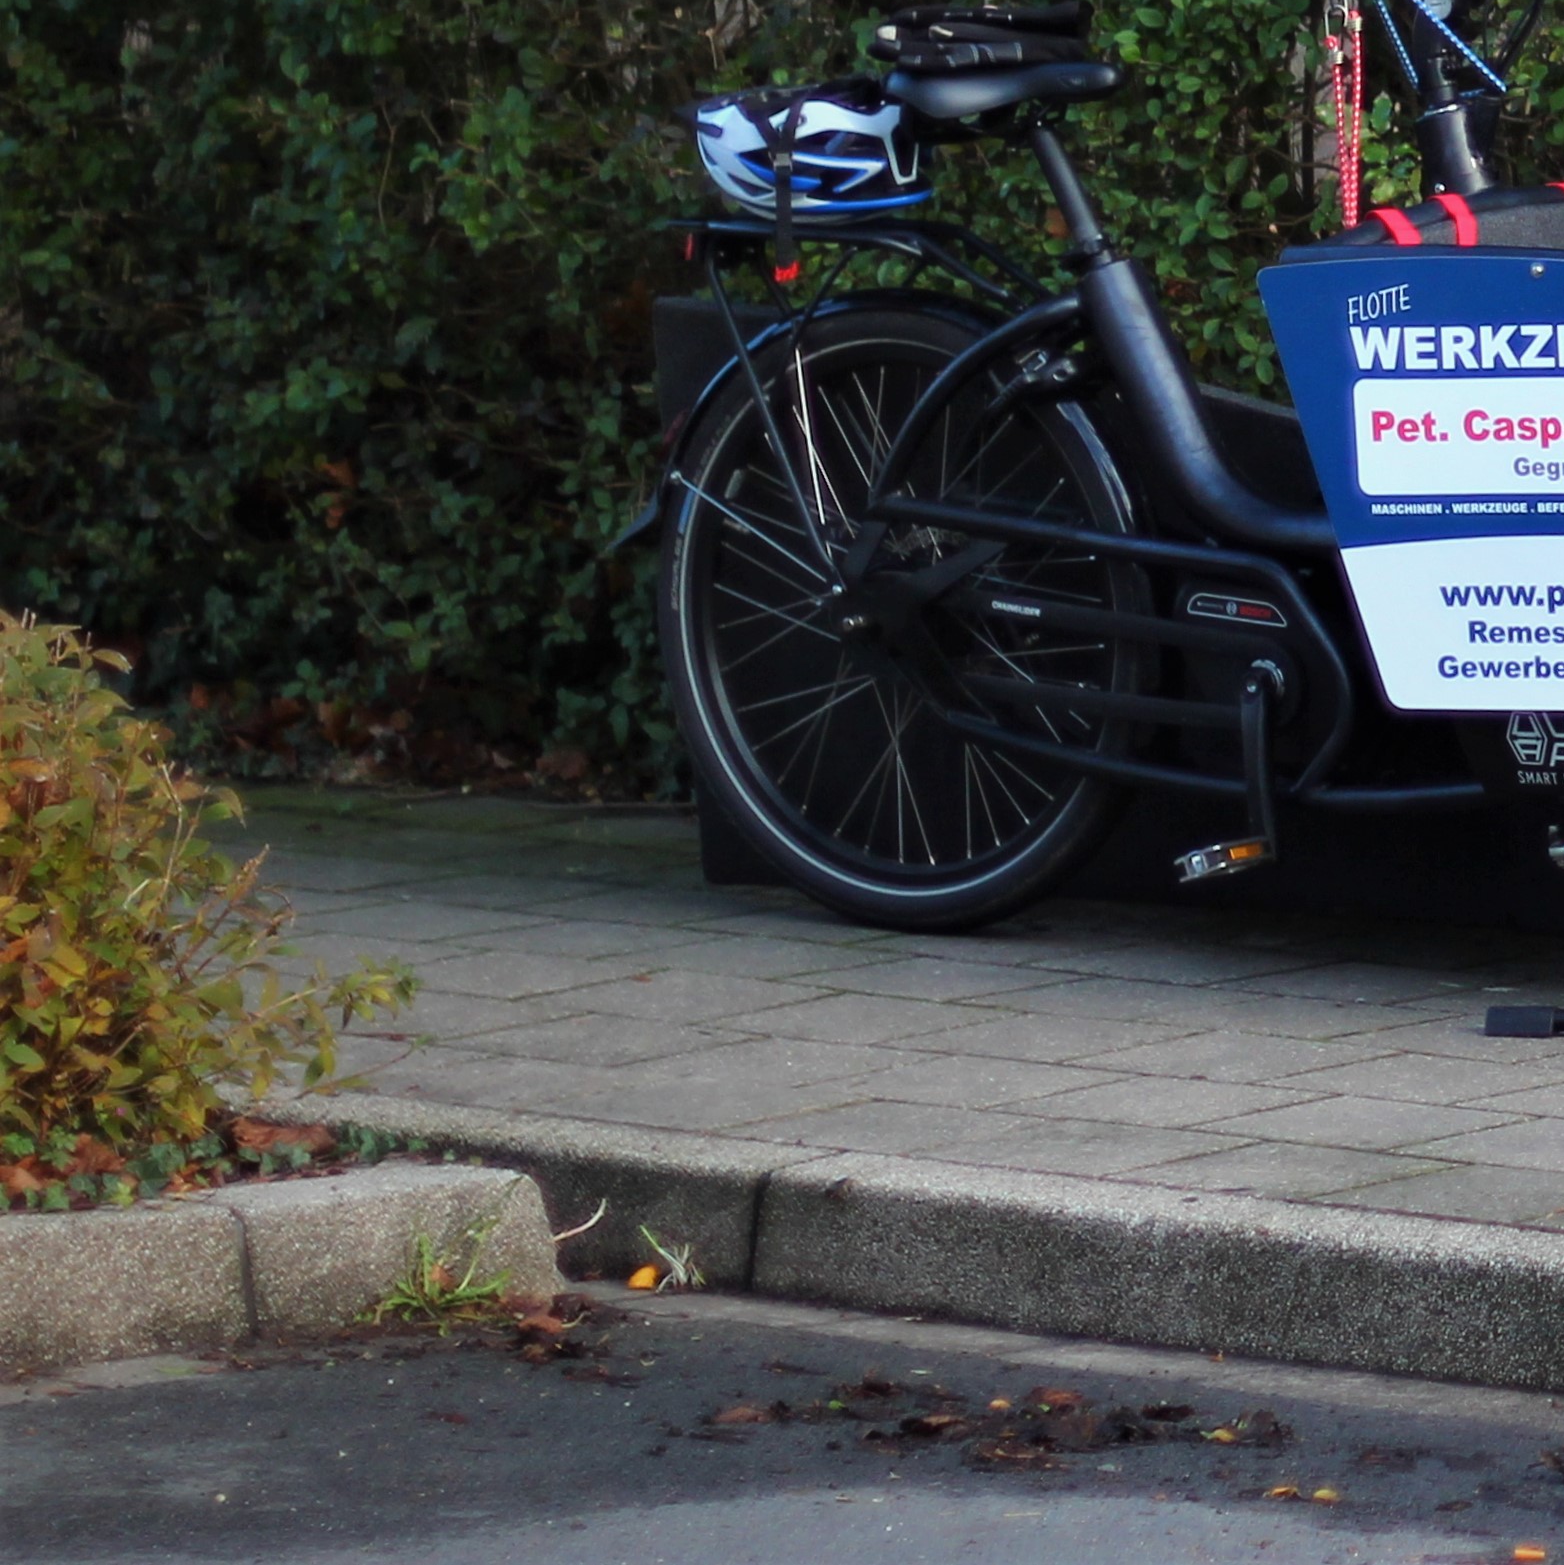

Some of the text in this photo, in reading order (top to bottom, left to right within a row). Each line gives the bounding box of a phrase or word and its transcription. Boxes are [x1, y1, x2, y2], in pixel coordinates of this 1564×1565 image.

[1347, 284, 1411, 323] FLOTTE
[1371, 410, 1448, 441] Pet.
[1371, 503, 1442, 514] MASCHINEN
[1452, 503, 1528, 514] WERKZEUGE
[1517, 770, 1557, 786] SMART
